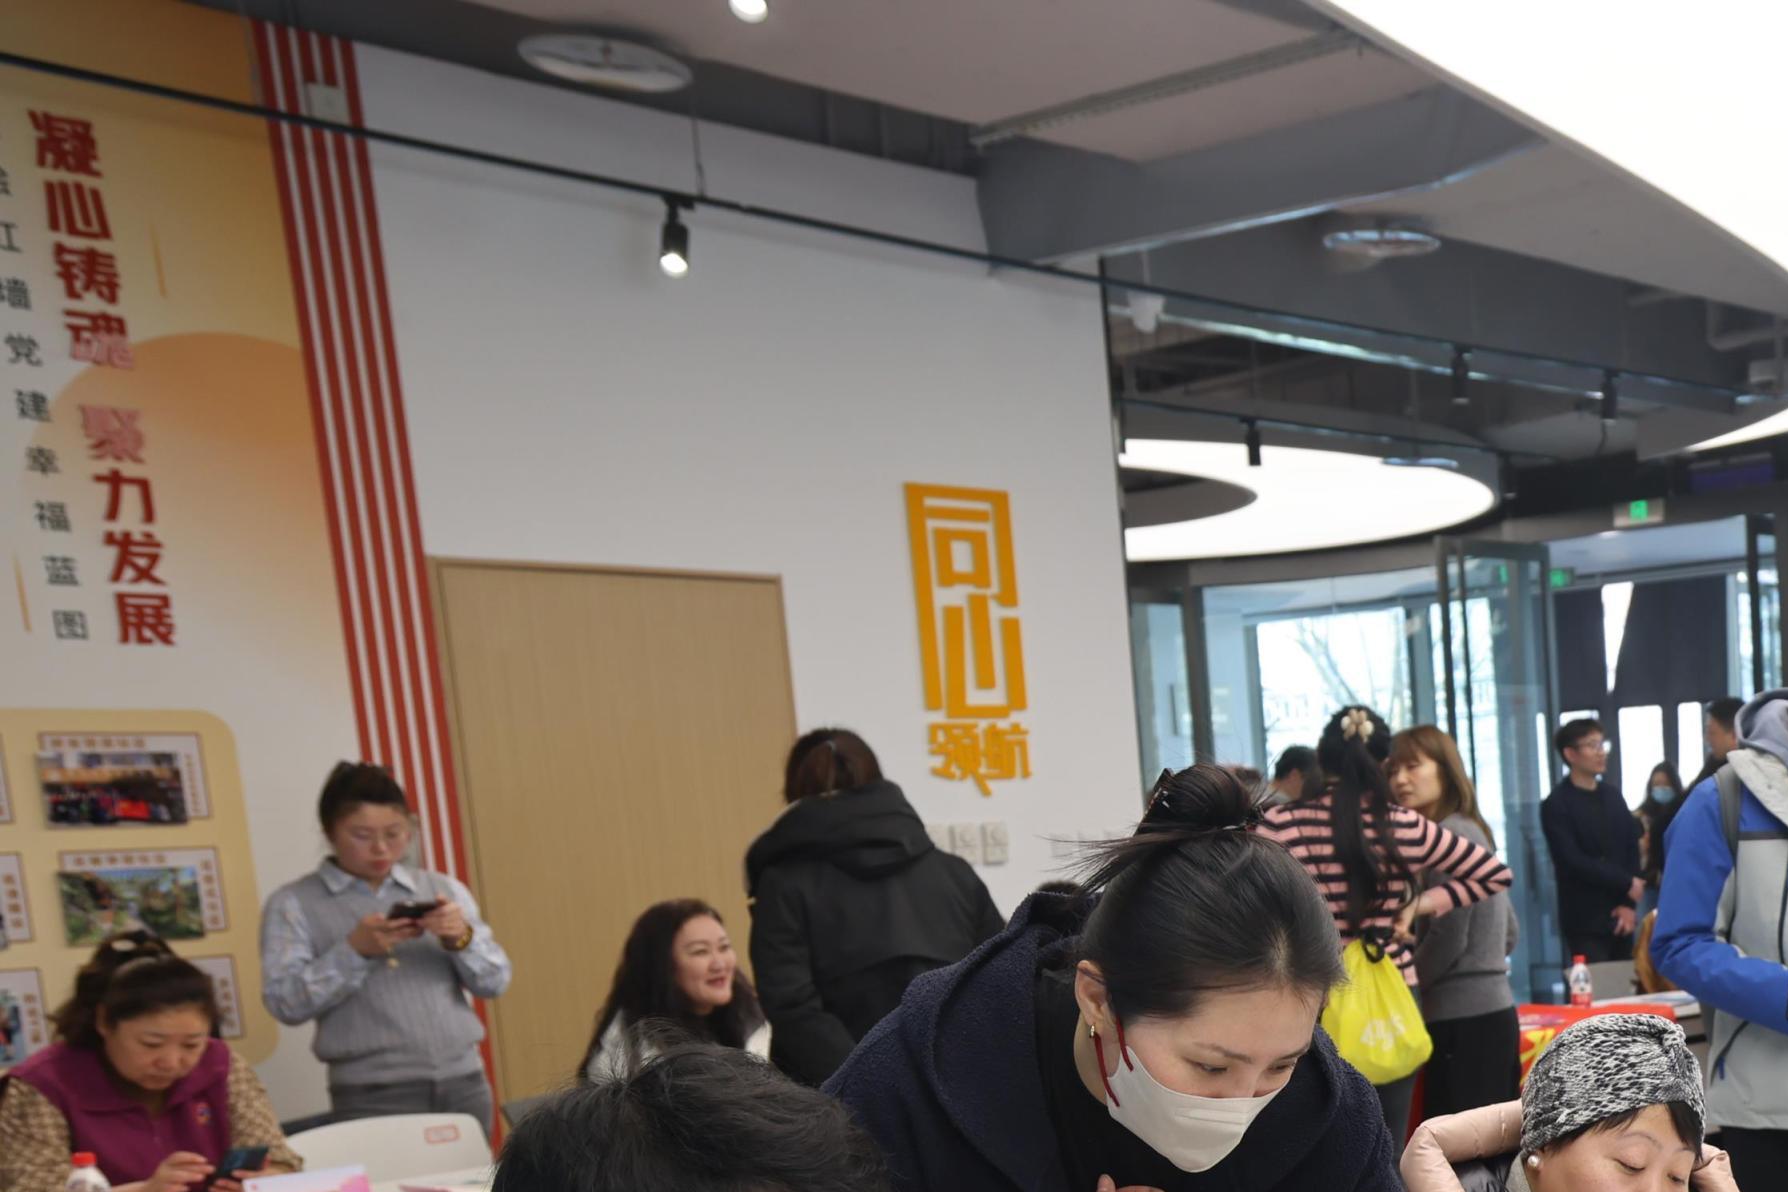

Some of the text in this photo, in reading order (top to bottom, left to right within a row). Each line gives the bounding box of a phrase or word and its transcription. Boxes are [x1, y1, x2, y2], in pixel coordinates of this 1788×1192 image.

[27, 109, 134, 370] 凝心铸魂
[0, 166, 90, 641] 墙党建幸福蓝图
[78, 404, 177, 646] 聚力发展
[927, 721, 1032, 797] 领航
